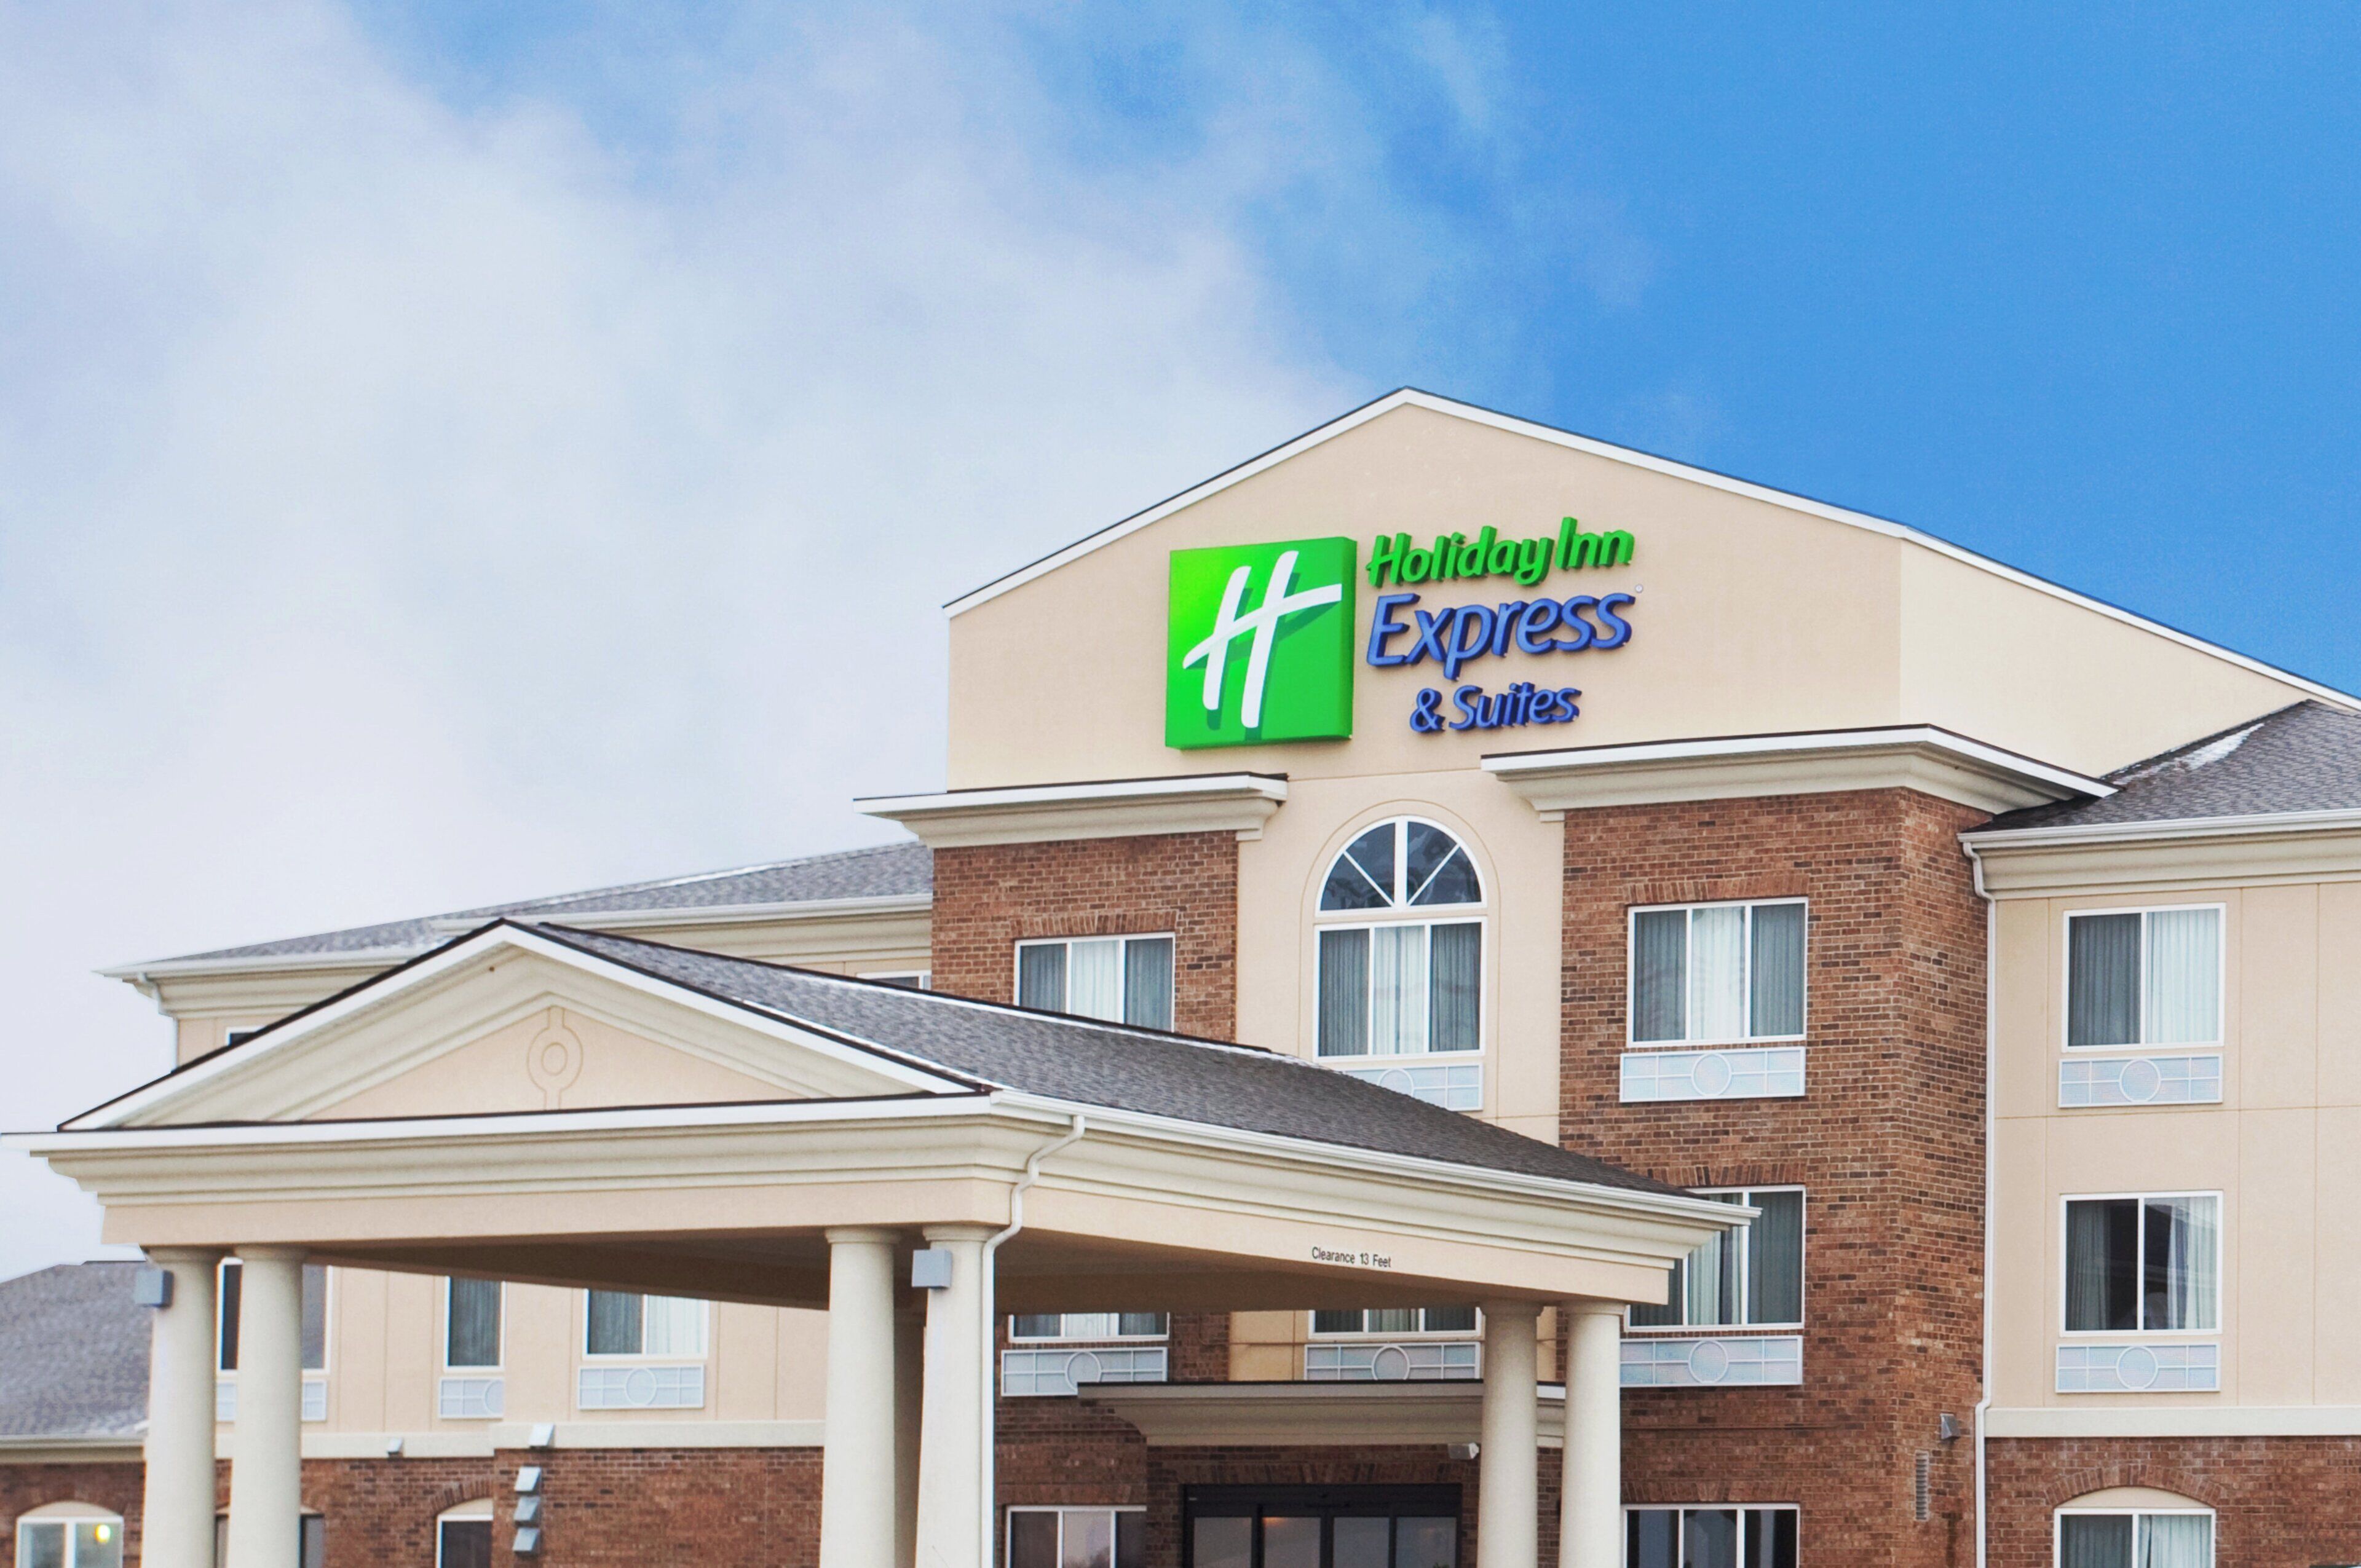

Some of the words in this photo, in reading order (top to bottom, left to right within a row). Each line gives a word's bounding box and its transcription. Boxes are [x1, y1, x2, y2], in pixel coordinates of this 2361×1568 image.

[1366, 524, 1554, 588] Holiday
[1555, 516, 1635, 570] Inn
[1366, 592, 1636, 680] Express
[1409, 687, 1445, 733] &
[1449, 682, 1582, 731] Suites
[1311, 1247, 1355, 1264] Clearance
[1359, 1253, 1369, 1265] 13
[1372, 1254, 1391, 1267] Feet
